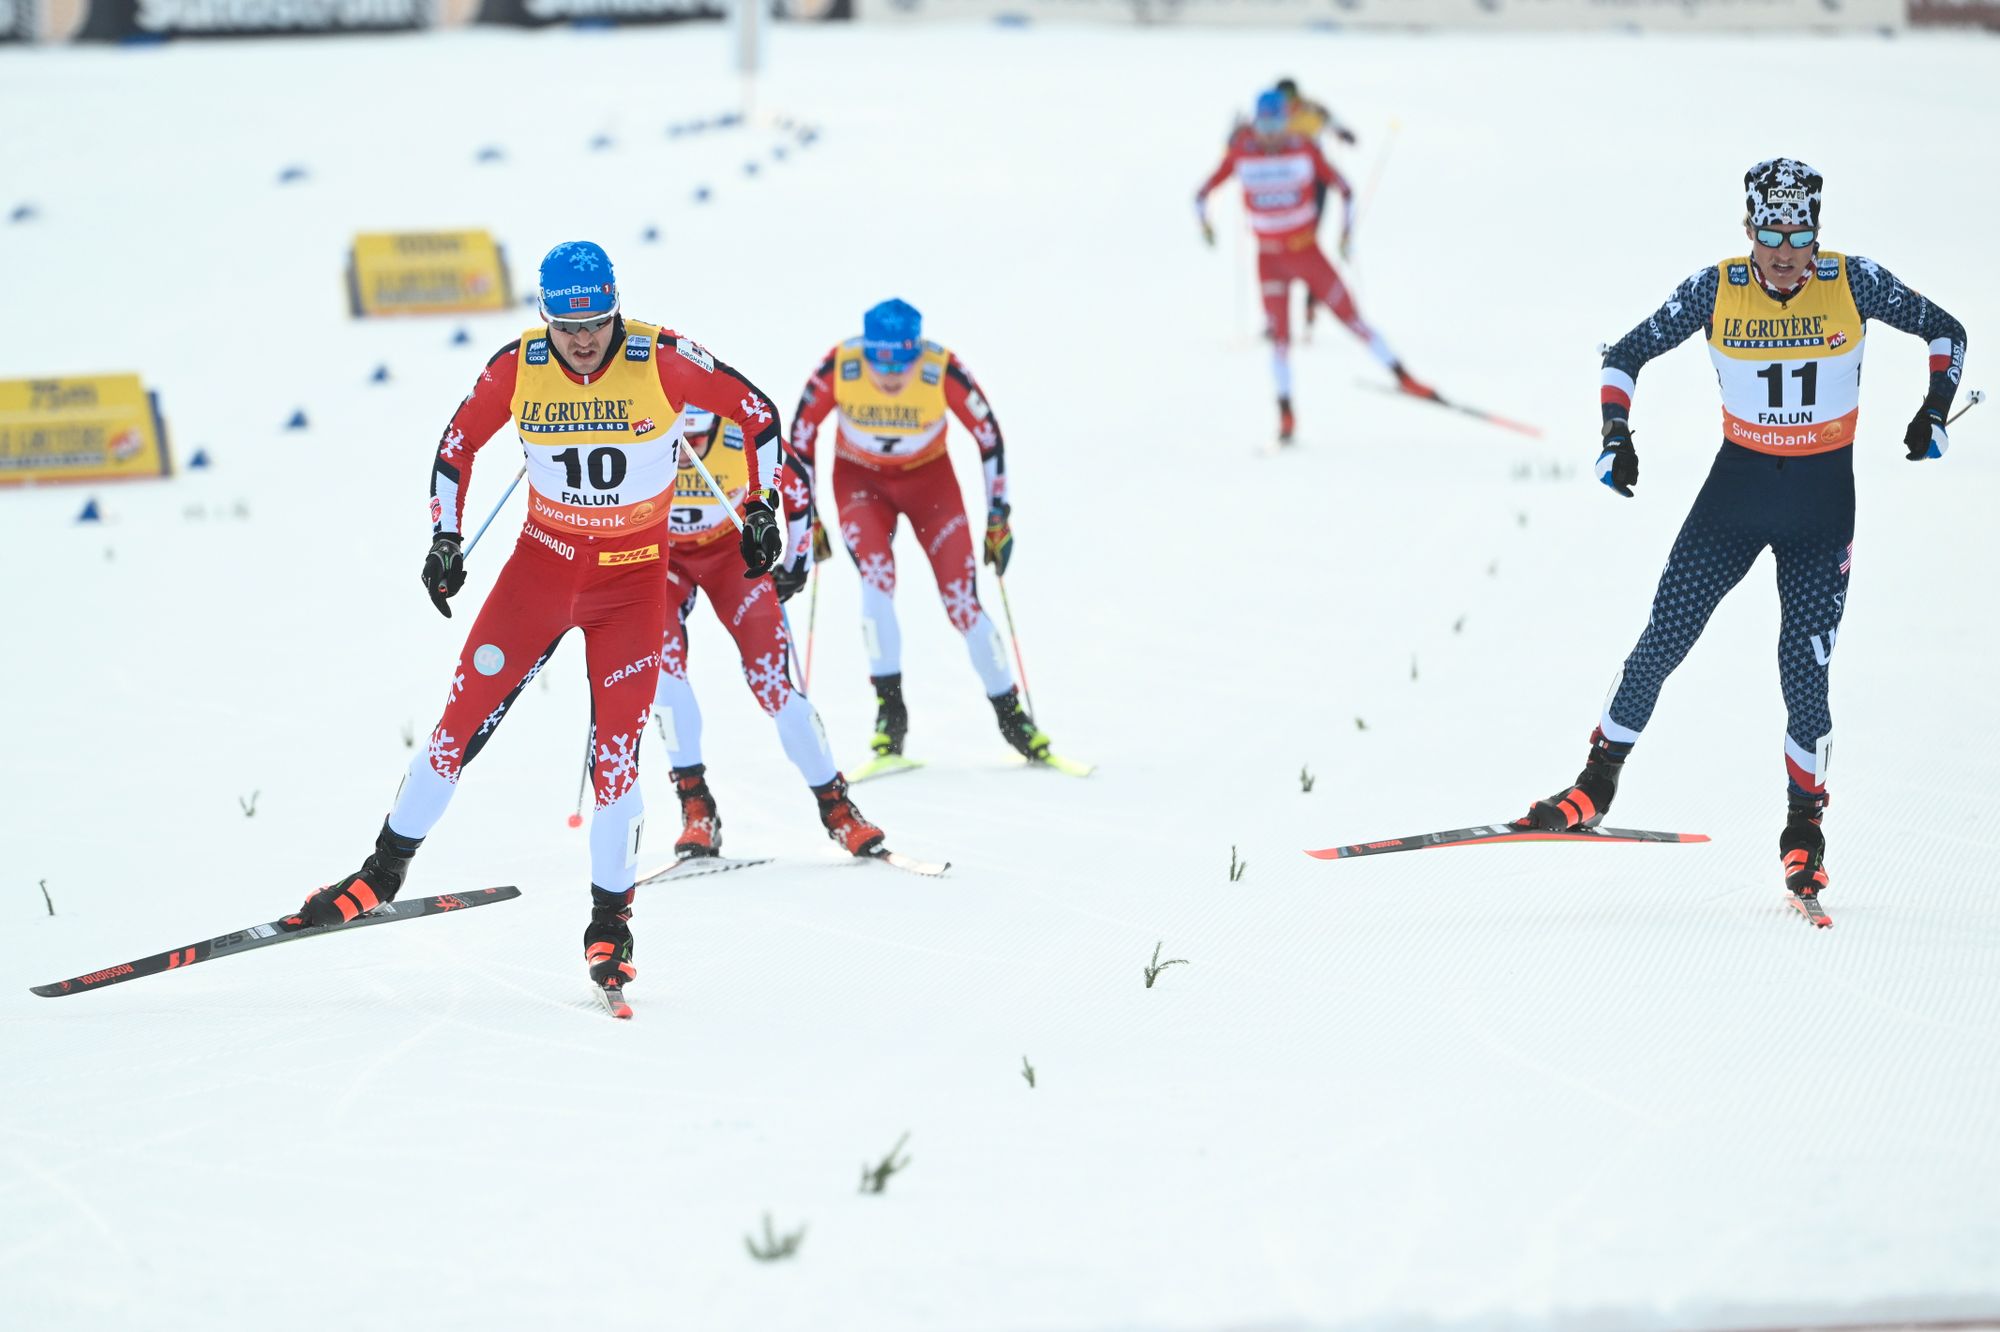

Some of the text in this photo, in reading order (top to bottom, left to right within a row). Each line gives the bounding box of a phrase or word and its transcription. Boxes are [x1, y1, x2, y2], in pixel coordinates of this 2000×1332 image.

[1817, 269, 1838, 277] coop
[546, 284, 602, 298] SpareBank
[1723, 315, 1824, 338] LE GRUYÈRE
[627, 349, 649, 358] coop
[1726, 338, 1820, 348] SWITZERLAND
[678, 348, 713, 372] TORGHATTEN
[1952, 344, 1962, 366] EASY
[1757, 361, 1818, 408] 11
[520, 397, 629, 422] LE GRUYÈRE
[1758, 411, 1812, 424] FALUN
[523, 423, 625, 432] SWITZERLAND
[1732, 423, 1817, 445] Swedbank
[551, 446, 627, 490] 10
[561, 491, 620, 506] FALUN
[534, 497, 626, 527] Swedbank
[608, 547, 655, 563] DHL
[733, 582, 768, 626] CRAFT
[604, 656, 654, 687] CRAFT
